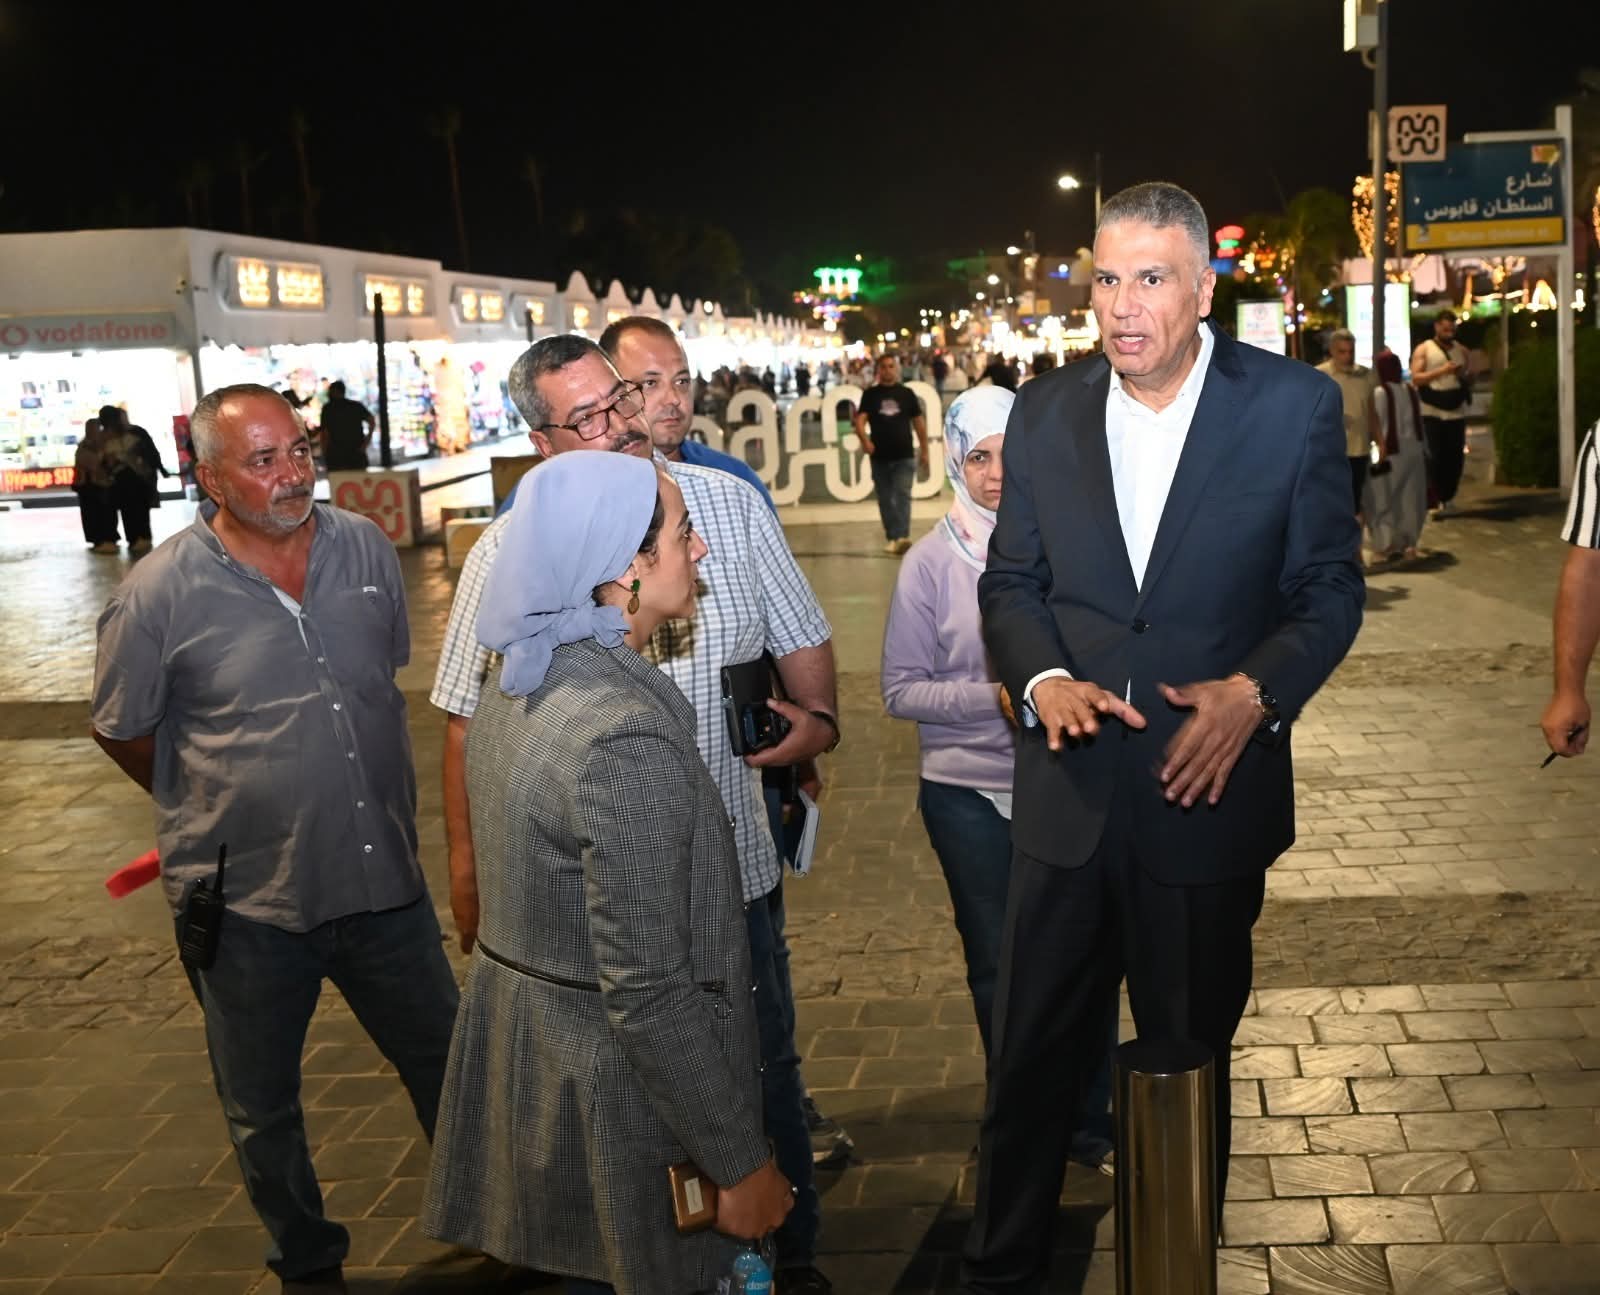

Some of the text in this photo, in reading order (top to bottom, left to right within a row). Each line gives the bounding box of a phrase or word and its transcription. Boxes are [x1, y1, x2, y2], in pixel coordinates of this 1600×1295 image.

[1505, 171, 1553, 195] شارع
[1424, 196, 1553, 221] السلطان قابوس
[34, 320, 166, 343] vodafone
